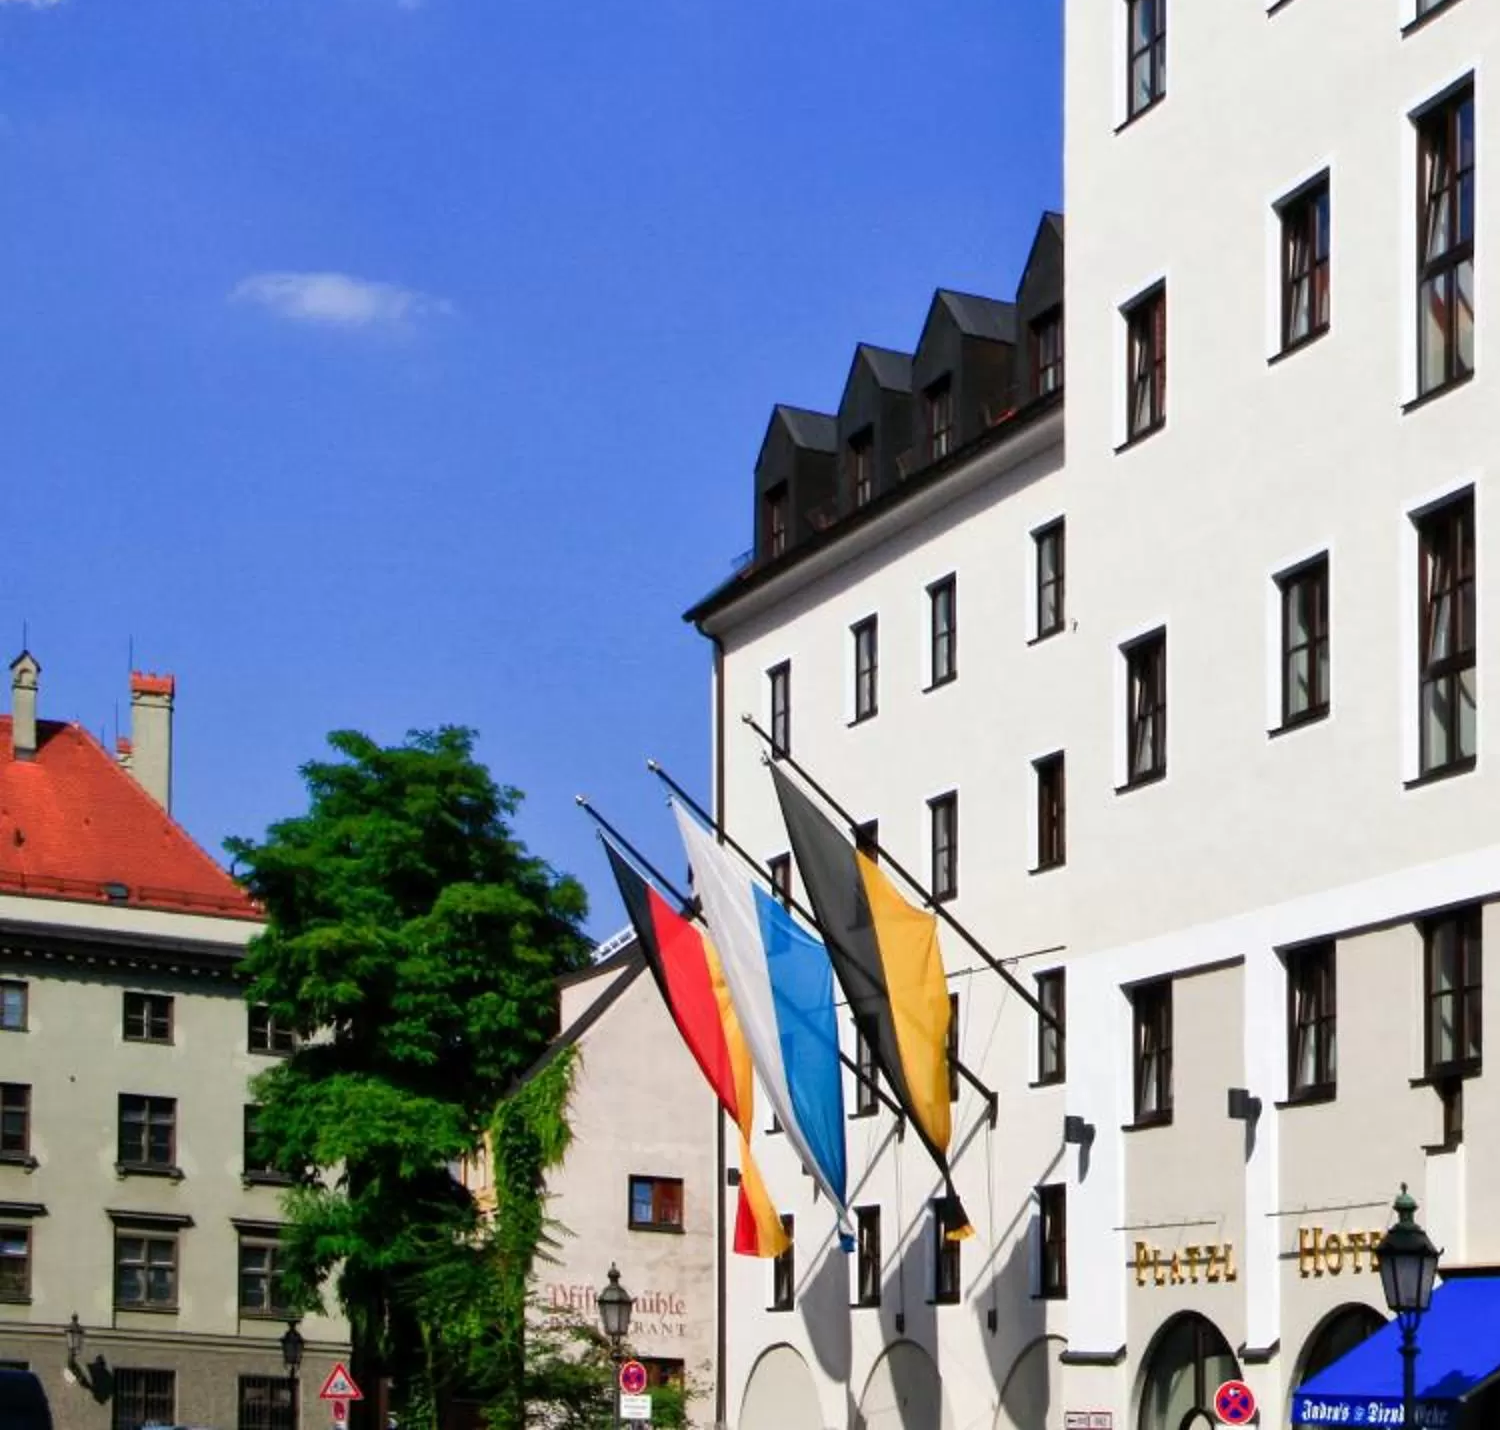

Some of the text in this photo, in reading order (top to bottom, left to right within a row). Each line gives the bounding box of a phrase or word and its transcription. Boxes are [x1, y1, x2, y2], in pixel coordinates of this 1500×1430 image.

[1134, 1241, 1237, 1287] PLATZL
[1299, 1227, 1383, 1279] HOTE
[546, 1283, 688, 1322] Pfistühle
[1367, 1401, 1449, 1425] DirndEcke
